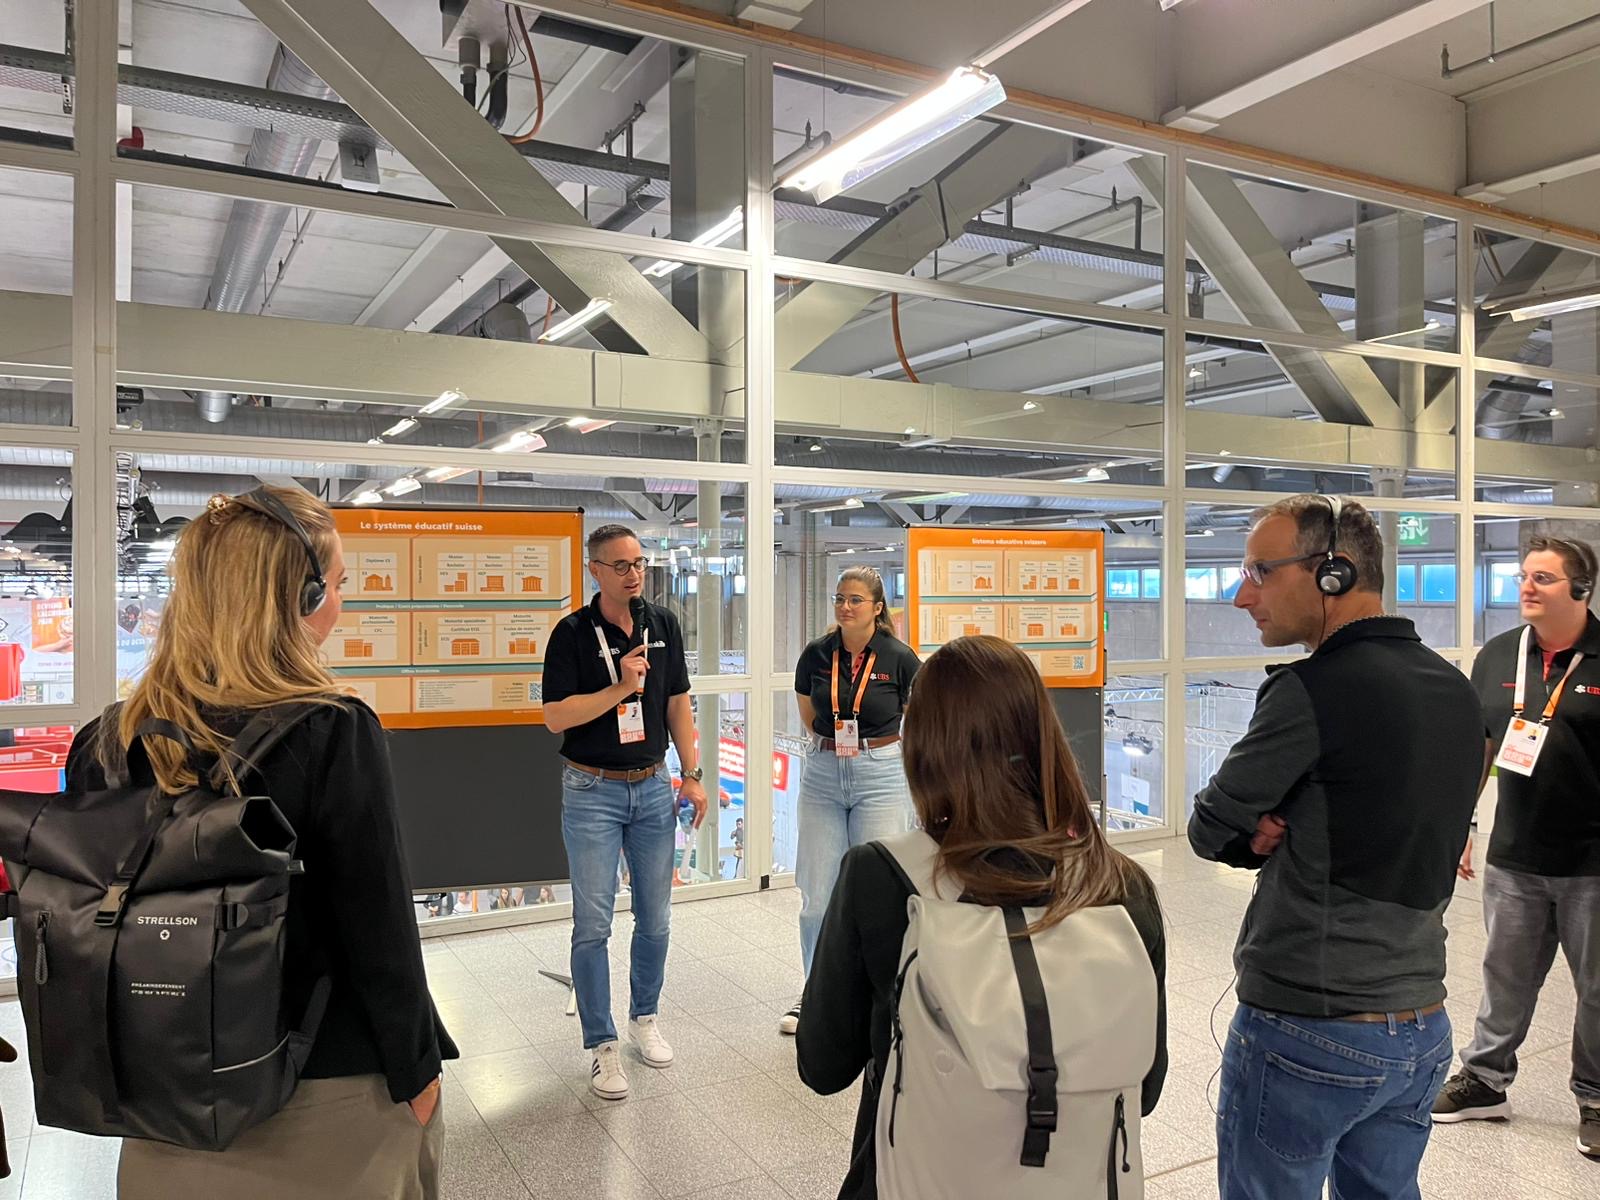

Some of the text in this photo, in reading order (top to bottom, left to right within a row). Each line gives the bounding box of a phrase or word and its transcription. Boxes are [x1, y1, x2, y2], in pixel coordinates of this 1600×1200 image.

[360, 521, 483, 531] Le système éducatif suisse
[137, 916, 198, 926] STRELLSON
